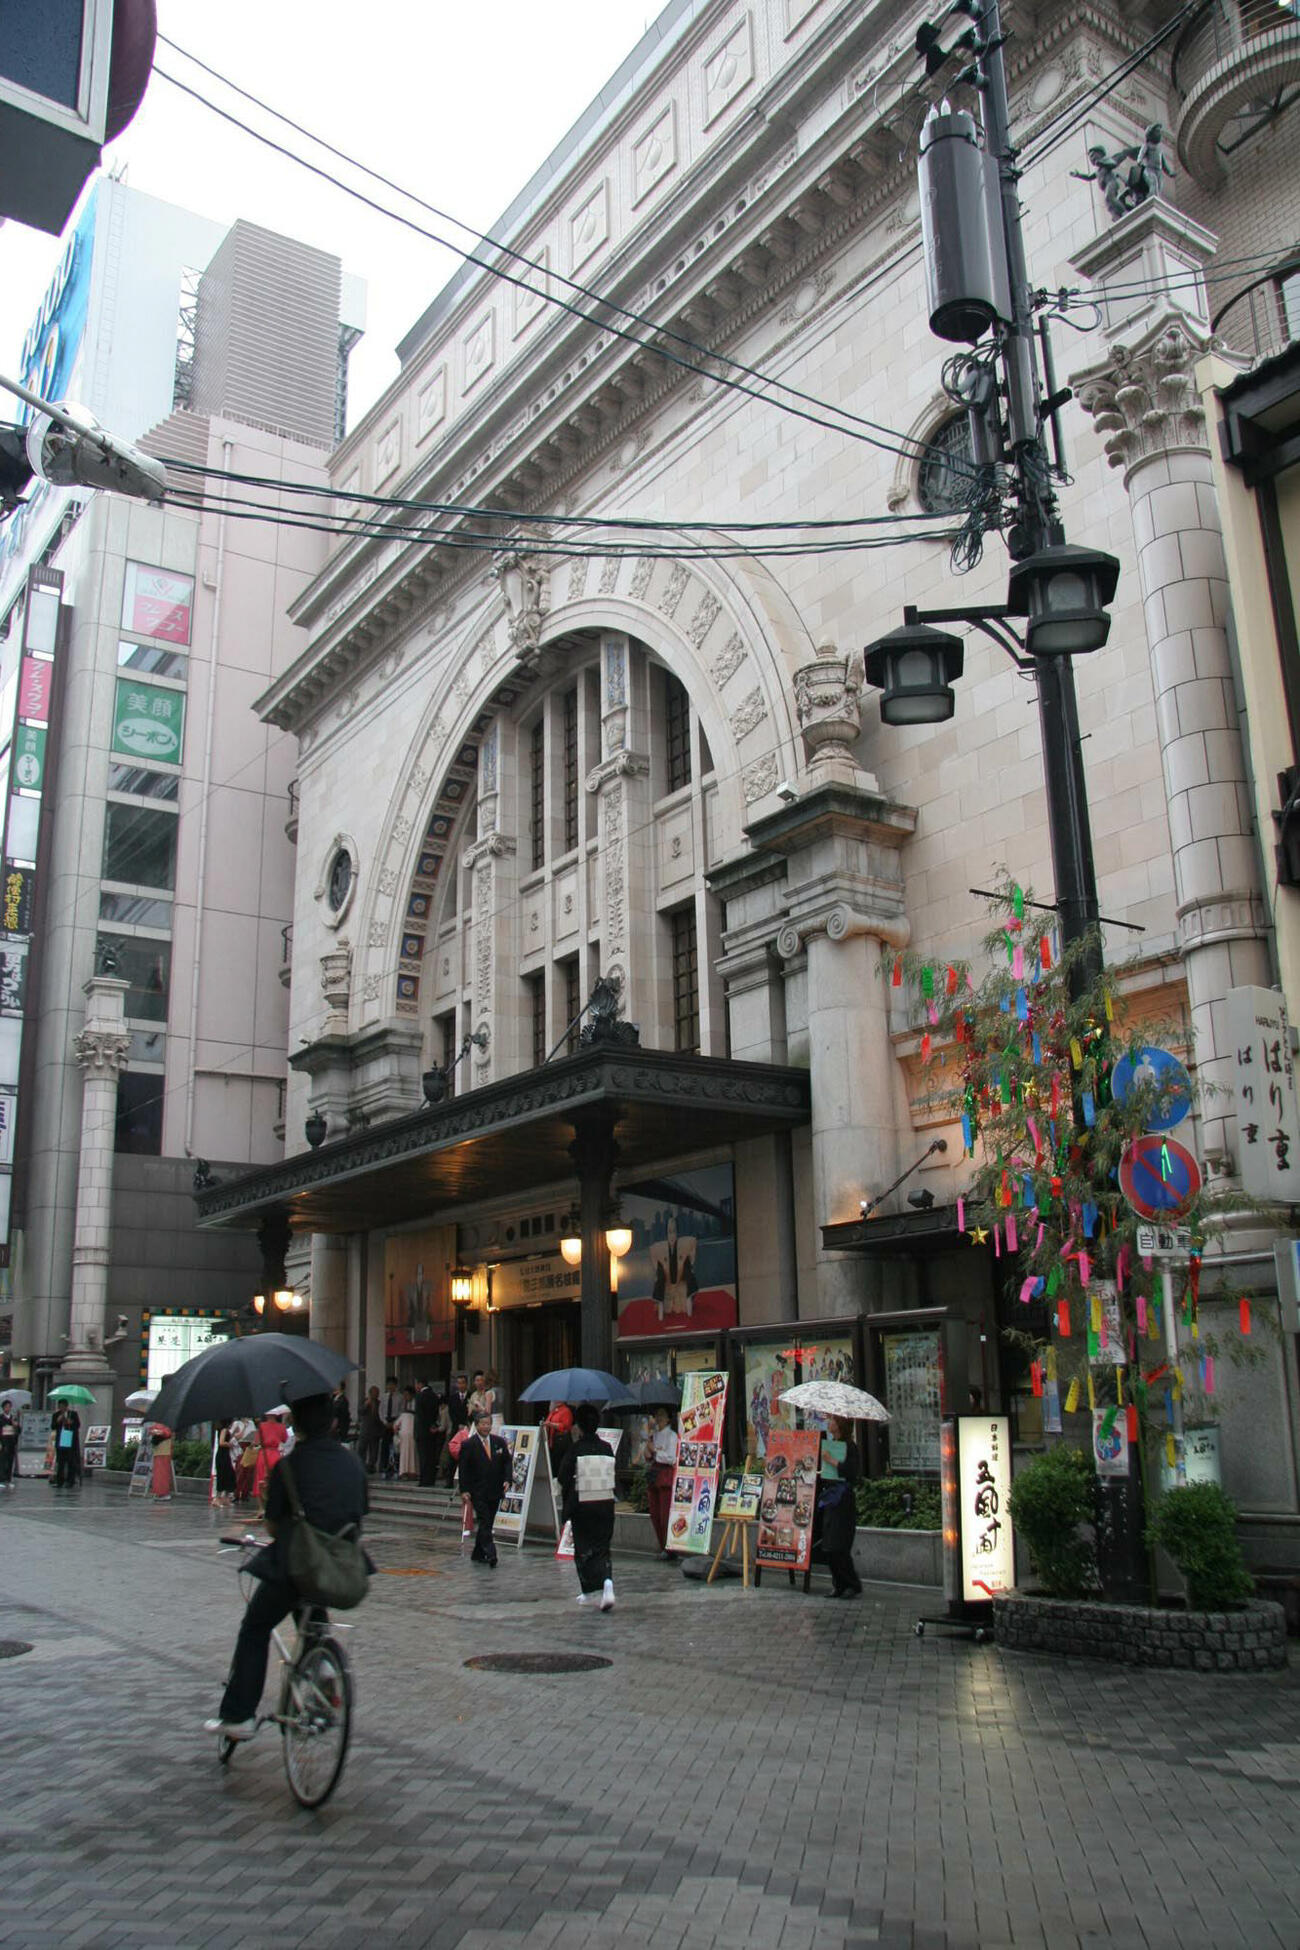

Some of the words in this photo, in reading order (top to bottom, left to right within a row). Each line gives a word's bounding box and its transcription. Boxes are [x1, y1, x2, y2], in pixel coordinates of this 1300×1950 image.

[126, 692, 173, 718] 美顔
[1238, 1044, 1259, 1145] はり重
[1262, 1037, 1290, 1172] はり重
[1140, 1232, 1192, 1250] 自動車
